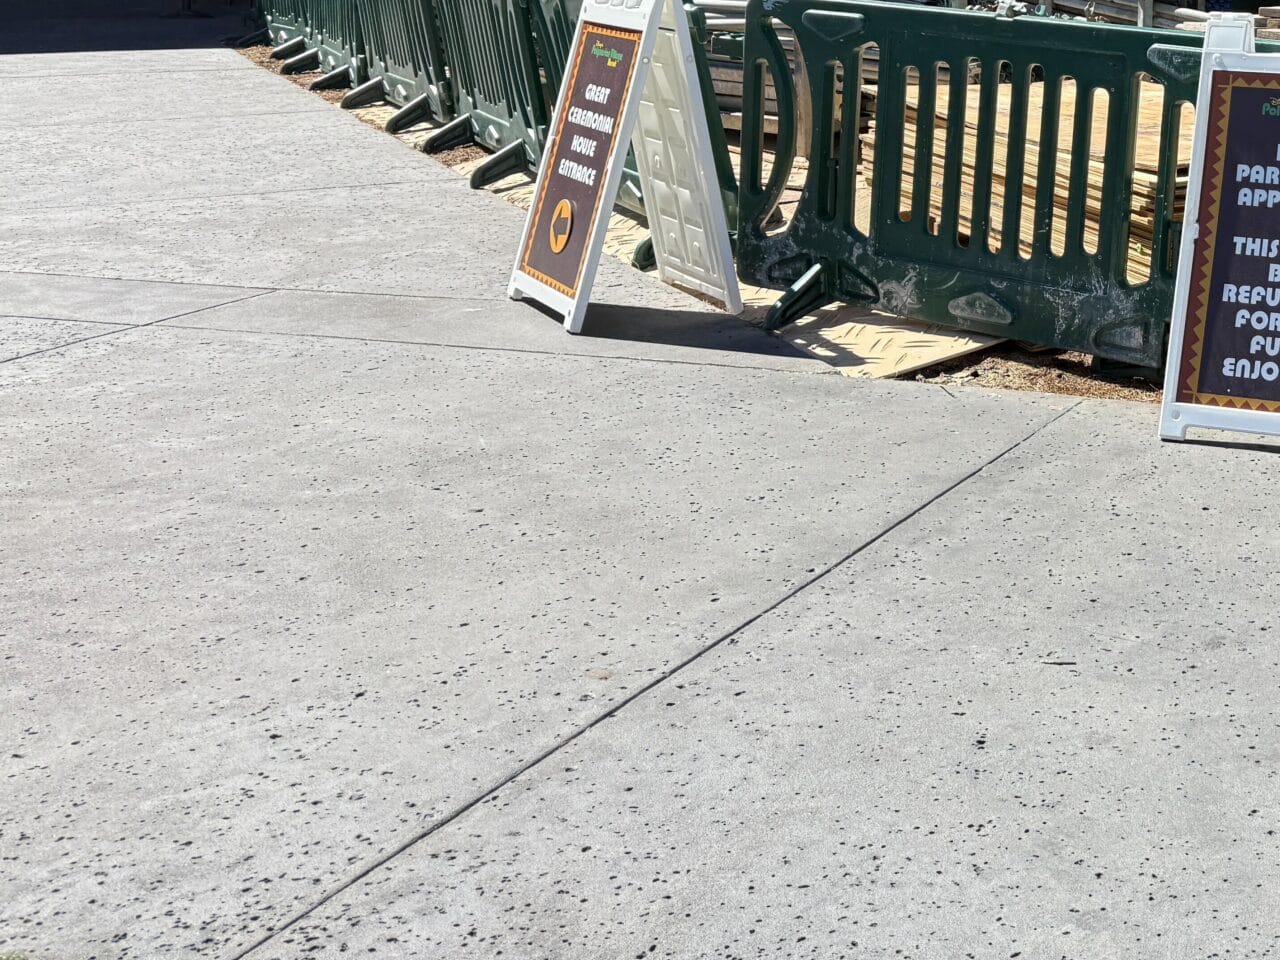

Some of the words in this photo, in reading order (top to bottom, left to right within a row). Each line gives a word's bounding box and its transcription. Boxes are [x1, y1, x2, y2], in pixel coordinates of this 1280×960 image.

[585, 84, 611, 104] GREAT
[568, 106, 614, 134] CEREMONIAL
[571, 135, 597, 157] HOUSE
[559, 159, 597, 186] ENTRANCE
[1233, 236, 1280, 258] THIS
